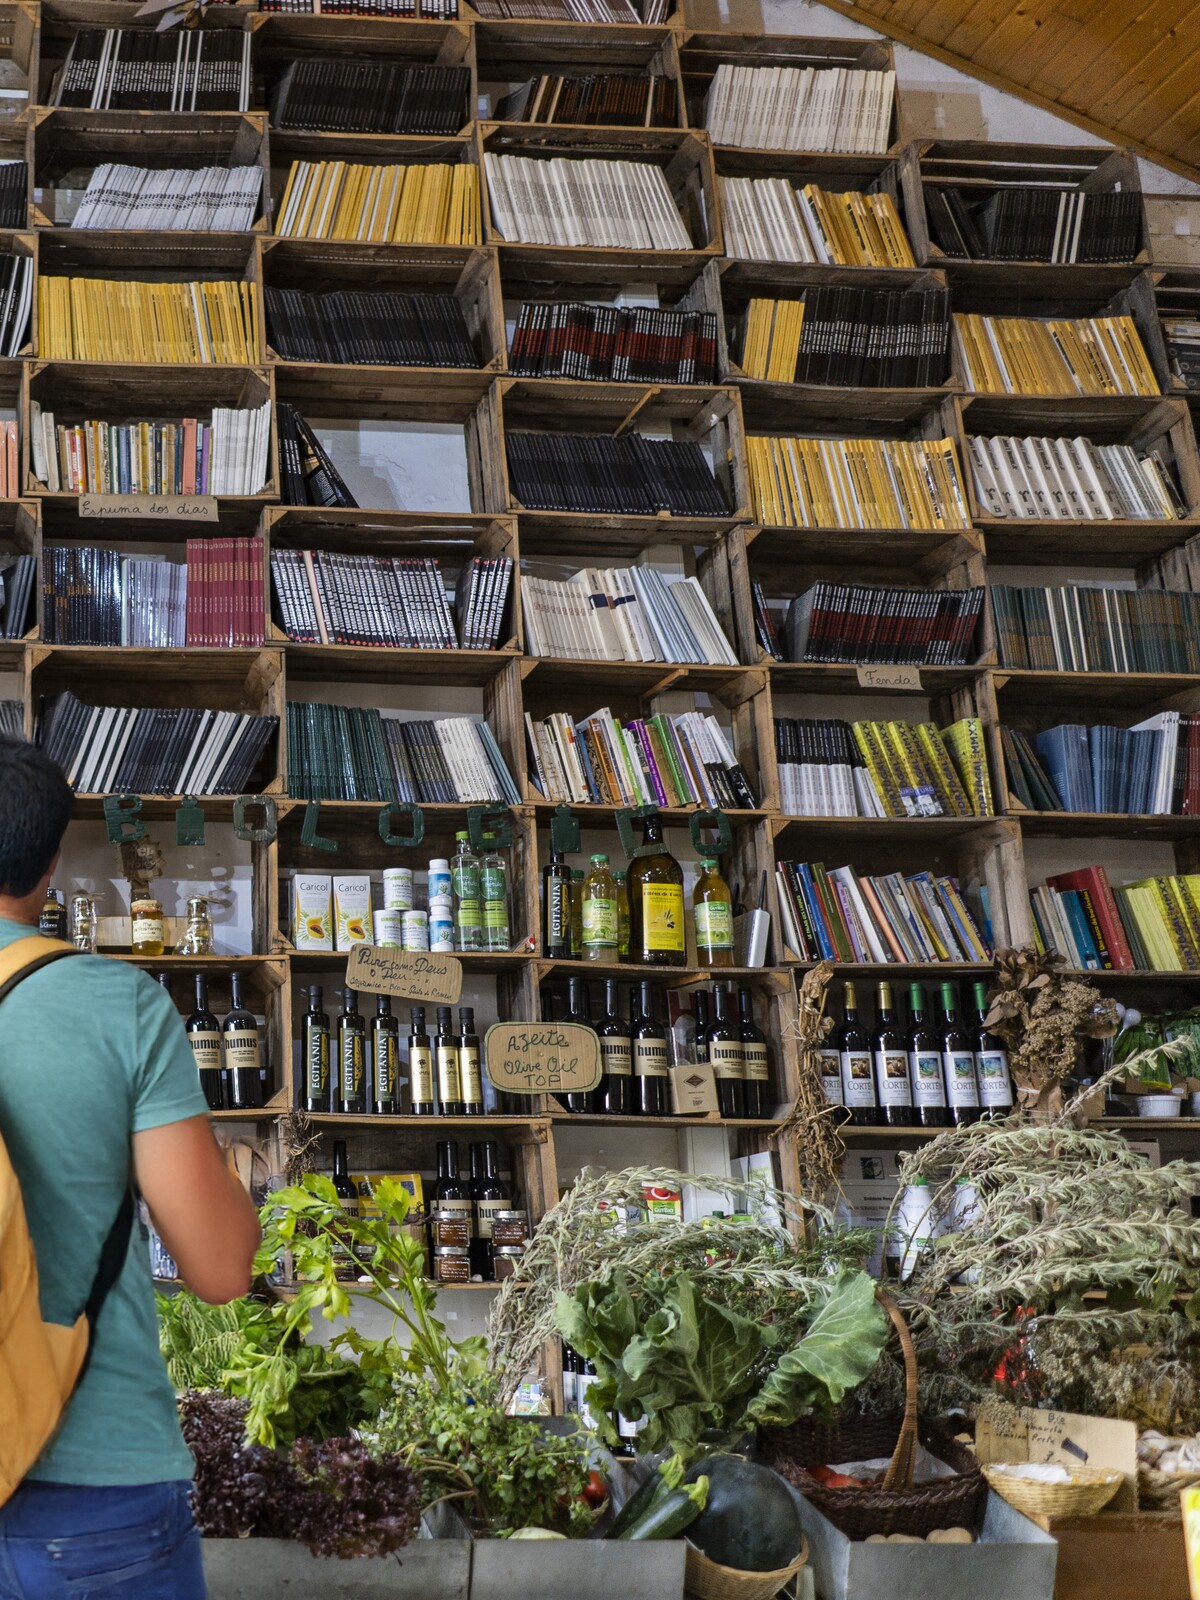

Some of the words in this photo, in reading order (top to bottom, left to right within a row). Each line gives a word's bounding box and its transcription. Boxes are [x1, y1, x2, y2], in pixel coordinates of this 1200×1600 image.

[82, 501, 142, 516] Espuma
[150, 503, 169, 514] dos
[177, 504, 208, 514] dias
[865, 670, 916, 685] Fenda
[300, 882, 328, 892] Caricol
[338, 883, 367, 893] Caricol
[552, 884, 561, 936] EGITÂNIA
[1083, 891, 1096, 918] berlindes
[1096, 940, 1106, 950] Um
[358, 948, 388, 967] Puro
[391, 962, 413, 971] como
[414, 958, 448, 975] Deus
[226, 1038, 257, 1049] humus
[508, 1030, 570, 1052] Azeite
[638, 1045, 667, 1057] humu
[311, 1034, 320, 1088] EGITÂNIA
[345, 1036, 353, 1091] EGITÂNIA
[379, 1038, 388, 1092] EGITÂNIA
[504, 1060, 542, 1074] Olive
[547, 1056, 578, 1074] Oil
[524, 1074, 560, 1086] TOP
[847, 1080, 873, 1090] CORTÉ
[951, 1080, 975, 1090] CORTÉ
